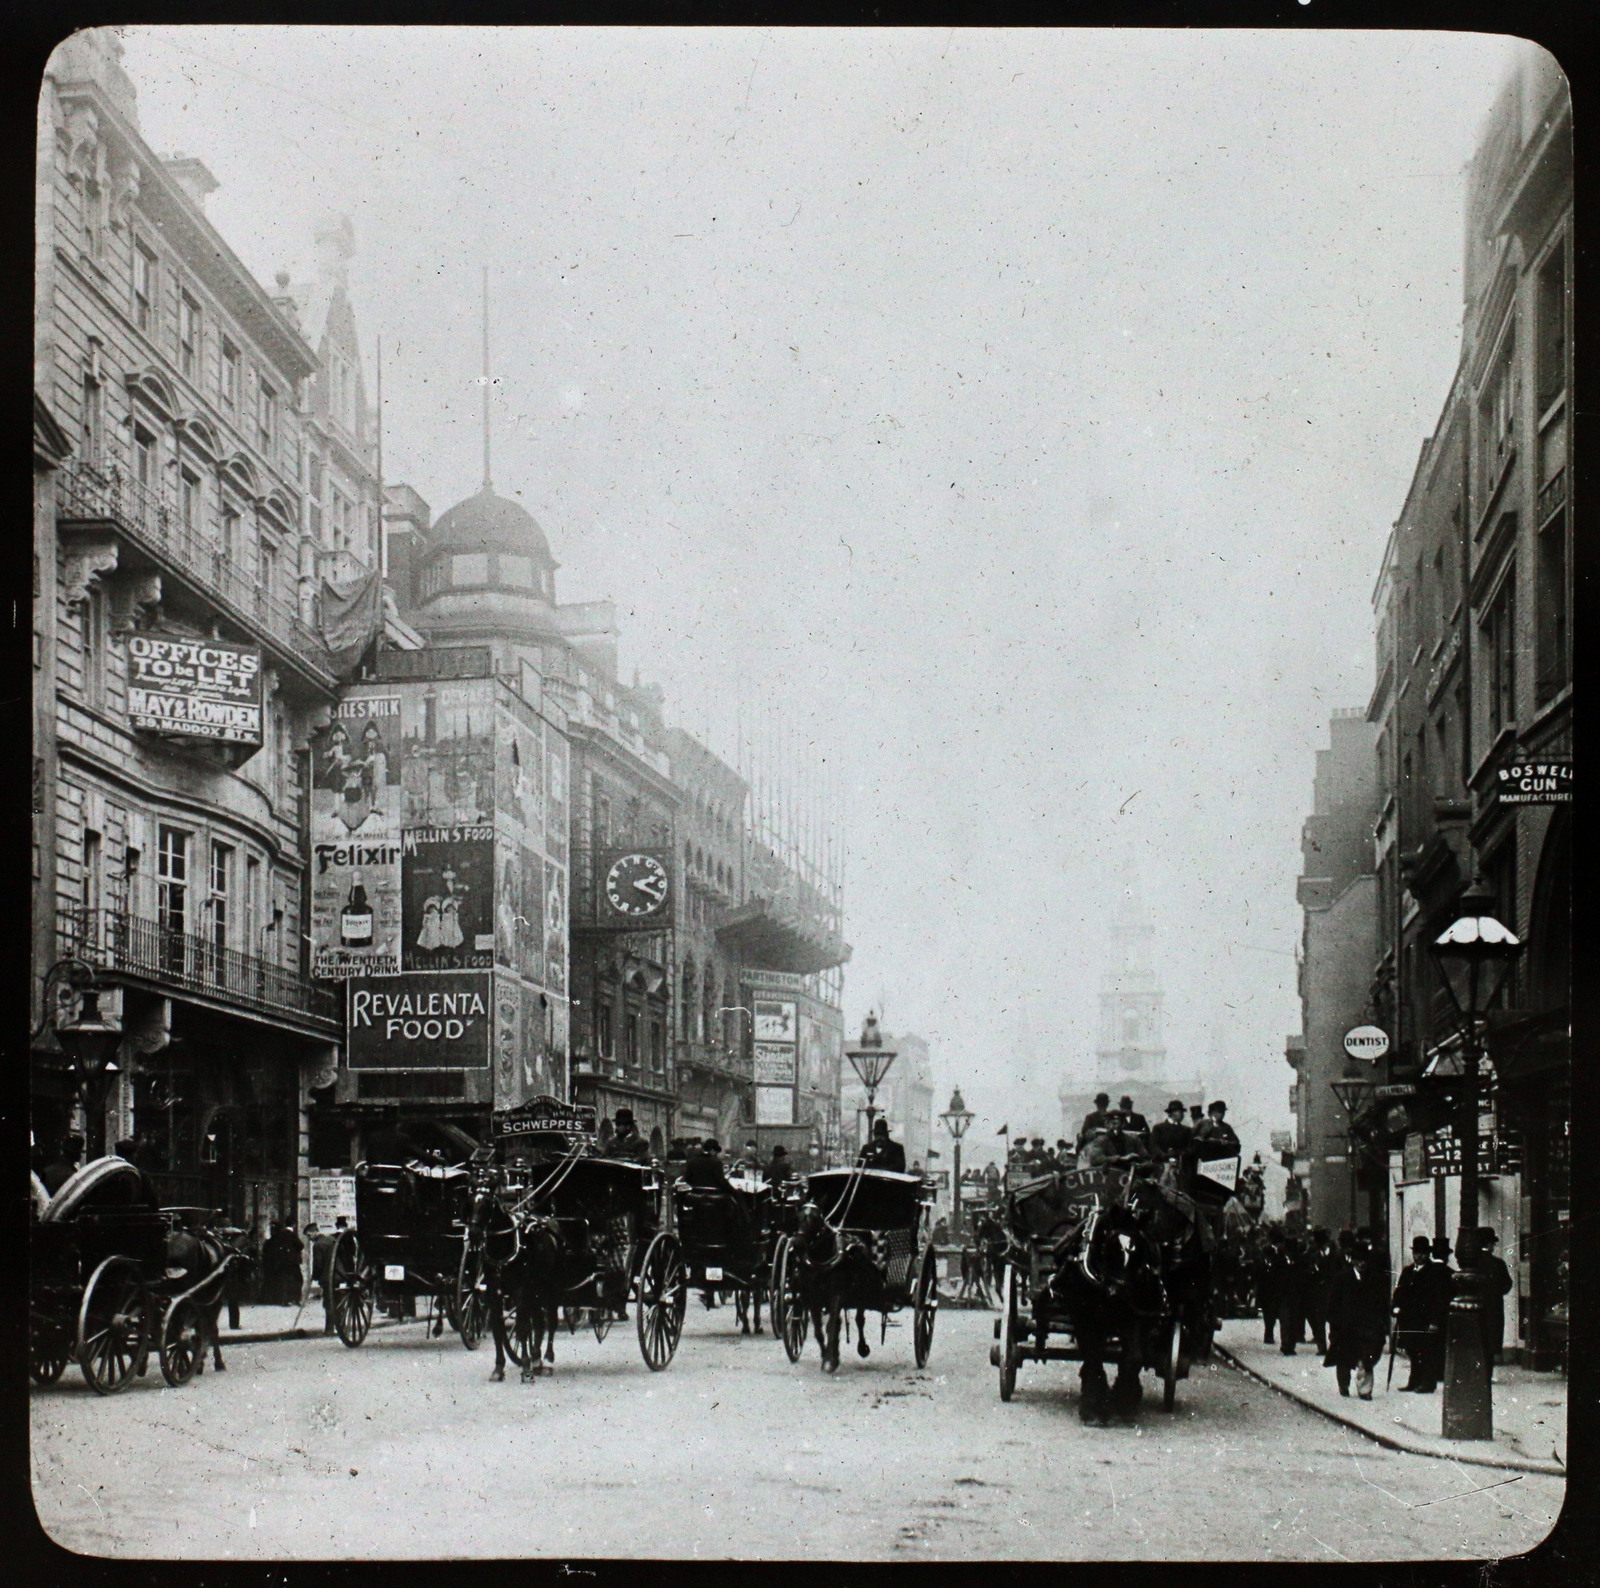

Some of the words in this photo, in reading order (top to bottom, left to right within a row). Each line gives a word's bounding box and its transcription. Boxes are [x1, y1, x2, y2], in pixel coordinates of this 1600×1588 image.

[128, 636, 259, 673] OFFICES
[133, 656, 173, 677] TO
[175, 662, 195, 677] be
[198, 665, 254, 688] LET
[368, 699, 399, 717] MILK
[161, 718, 220, 737] MADDOX
[1519, 778, 1558, 792] GUN
[463, 827, 493, 842] FOOD
[314, 843, 401, 875] Felixir
[312, 965, 362, 978] CENTURY
[364, 964, 400, 977] DRINK
[352, 990, 486, 1028] REVALENTA
[1346, 1036, 1388, 1047] DENTIST
[1066, 1170, 1107, 1189] CITY
